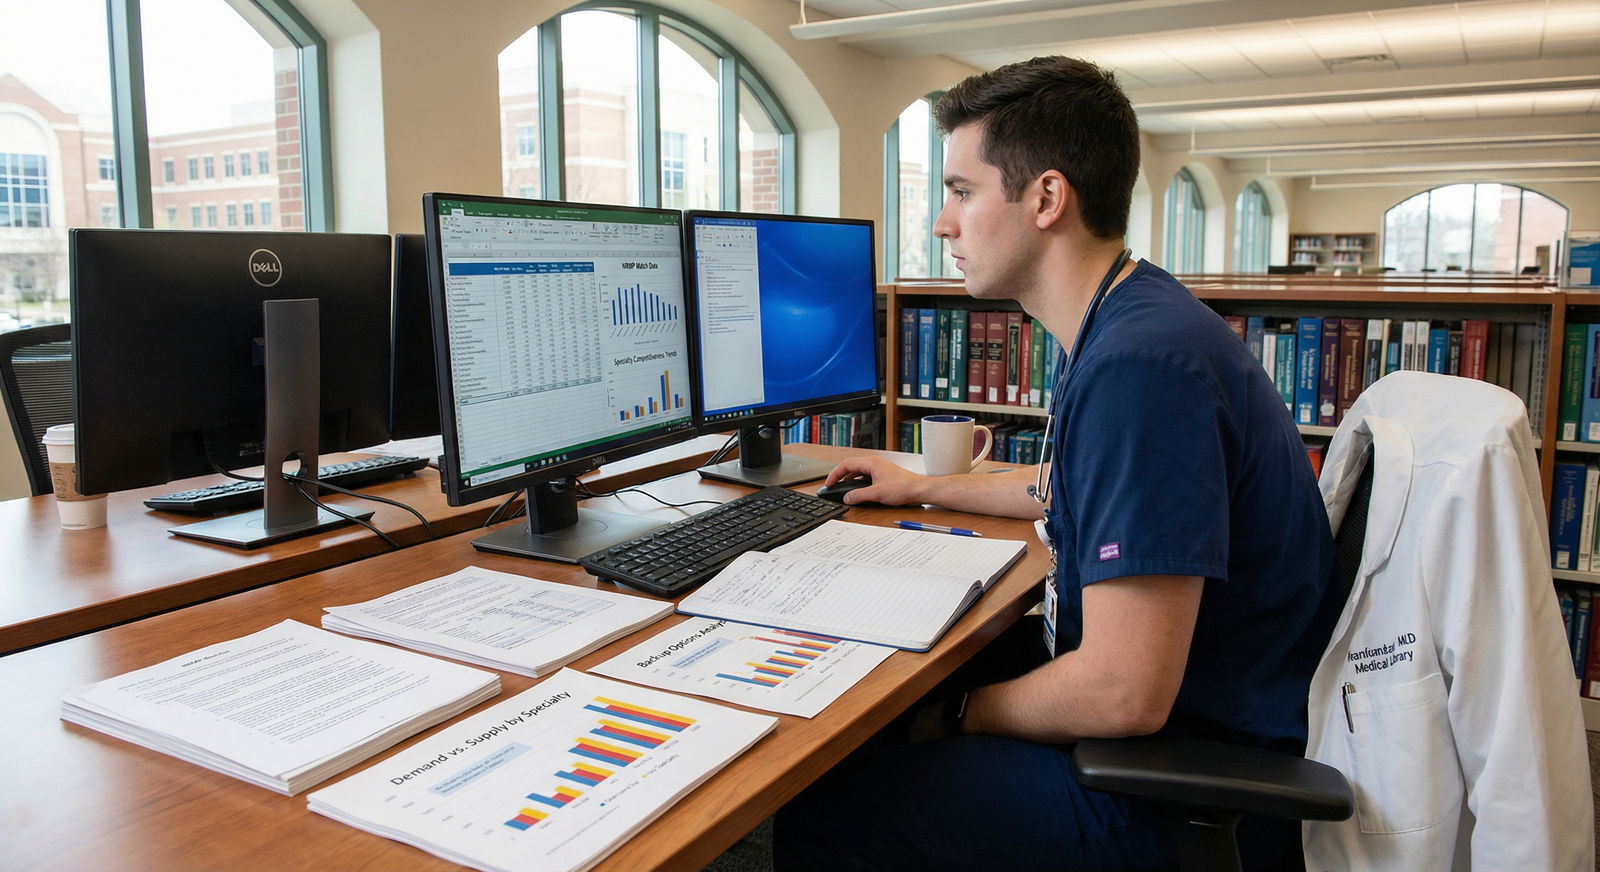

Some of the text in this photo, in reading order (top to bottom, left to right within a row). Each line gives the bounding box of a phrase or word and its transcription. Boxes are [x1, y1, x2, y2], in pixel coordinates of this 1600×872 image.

[252, 262, 279, 273] DELL
[649, 262, 659, 270] Data
[637, 649, 671, 668] Backup
[668, 633, 702, 651] Options
[1354, 657, 1389, 674] Medical
[390, 753, 448, 786] Demand
[447, 745, 469, 757] vs.
[465, 723, 508, 747] Supply
[505, 715, 525, 726] by
[521, 690, 571, 718] Specialty
